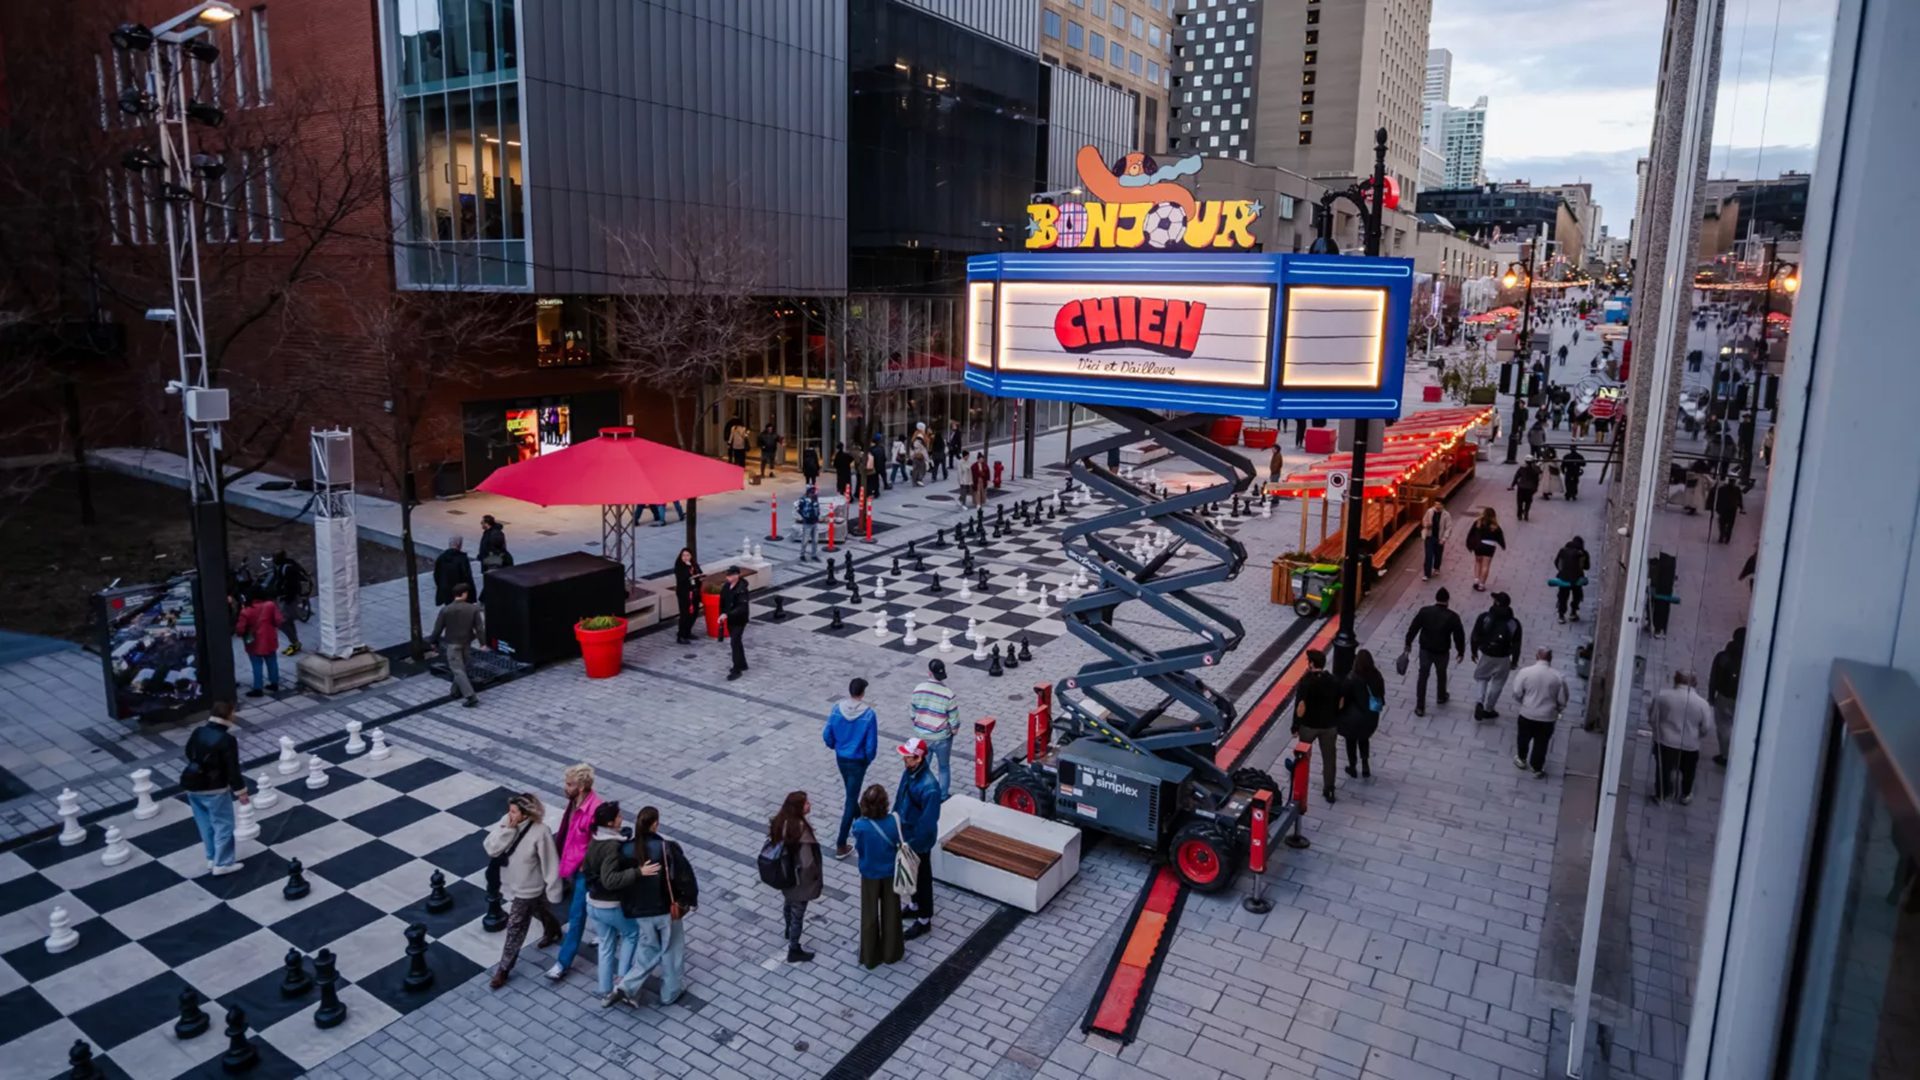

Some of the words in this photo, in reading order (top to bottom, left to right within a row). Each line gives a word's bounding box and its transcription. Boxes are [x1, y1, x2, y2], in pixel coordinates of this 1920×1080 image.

[1025, 201, 1260, 249] BONJOUR
[1054, 296, 1207, 356] CHIEN
[1104, 361, 1117, 371] et
[1096, 778, 1138, 798] simplex
